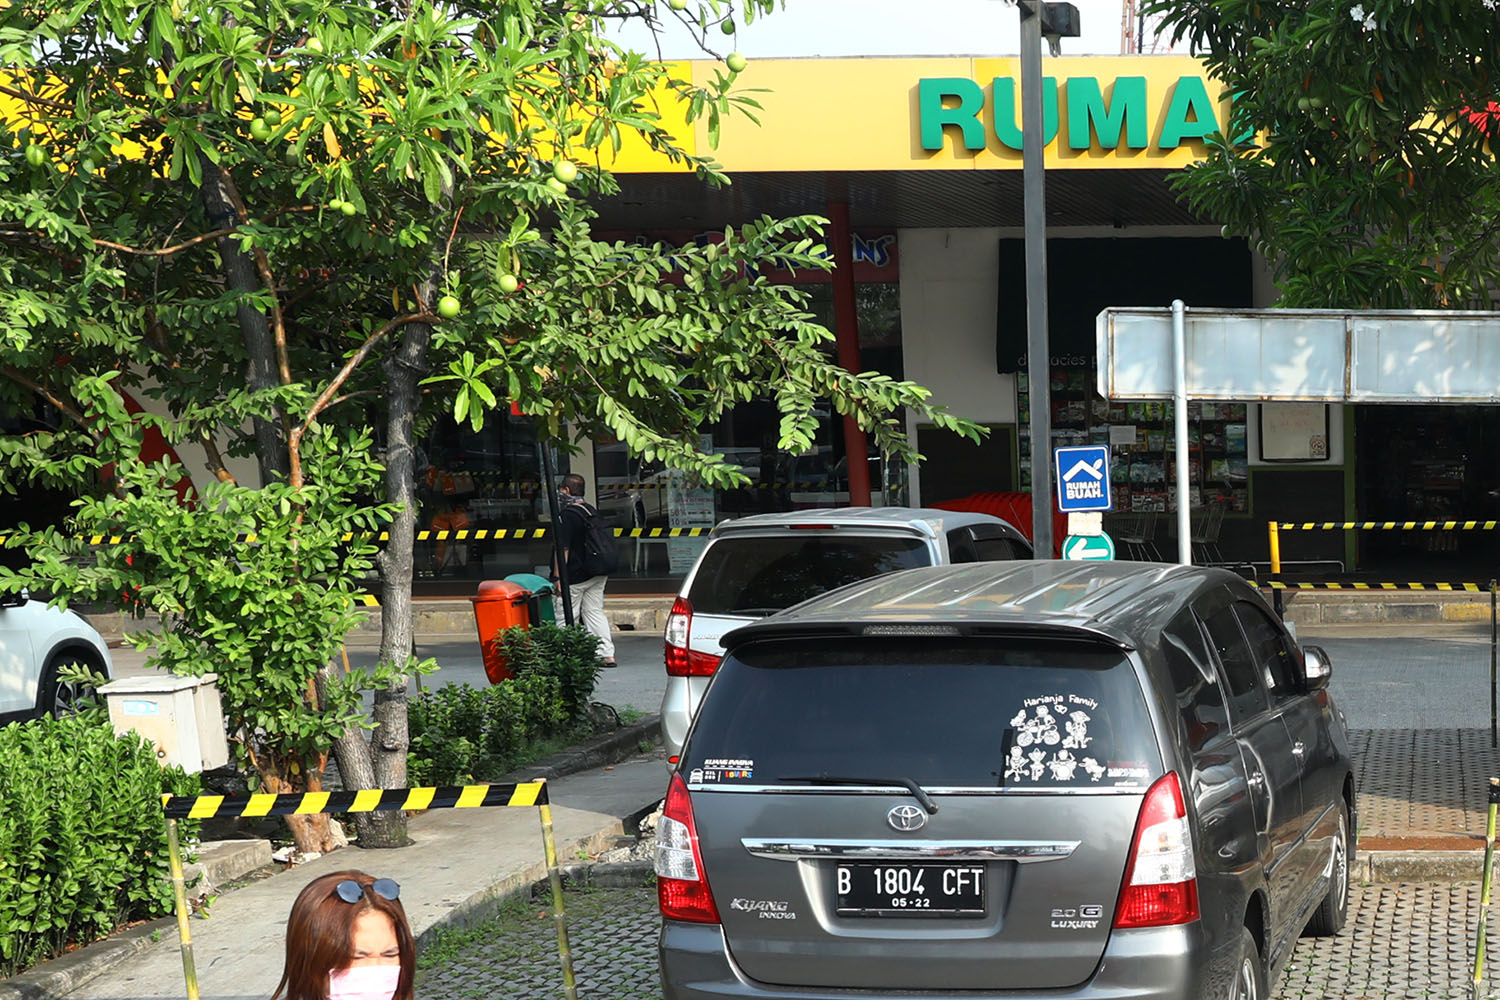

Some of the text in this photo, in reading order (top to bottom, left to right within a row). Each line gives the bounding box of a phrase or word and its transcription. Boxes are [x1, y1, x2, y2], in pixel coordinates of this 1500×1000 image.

[1018, 353, 1086, 366] dacies
[1065, 481, 1100, 490] RUMAH
[1023, 694, 1099, 711] Harianja Family
[837, 867, 984, 896] B 1804 CFT
[759, 911, 796, 920] INNOVA
[1051, 920, 1099, 929] LUXURY
